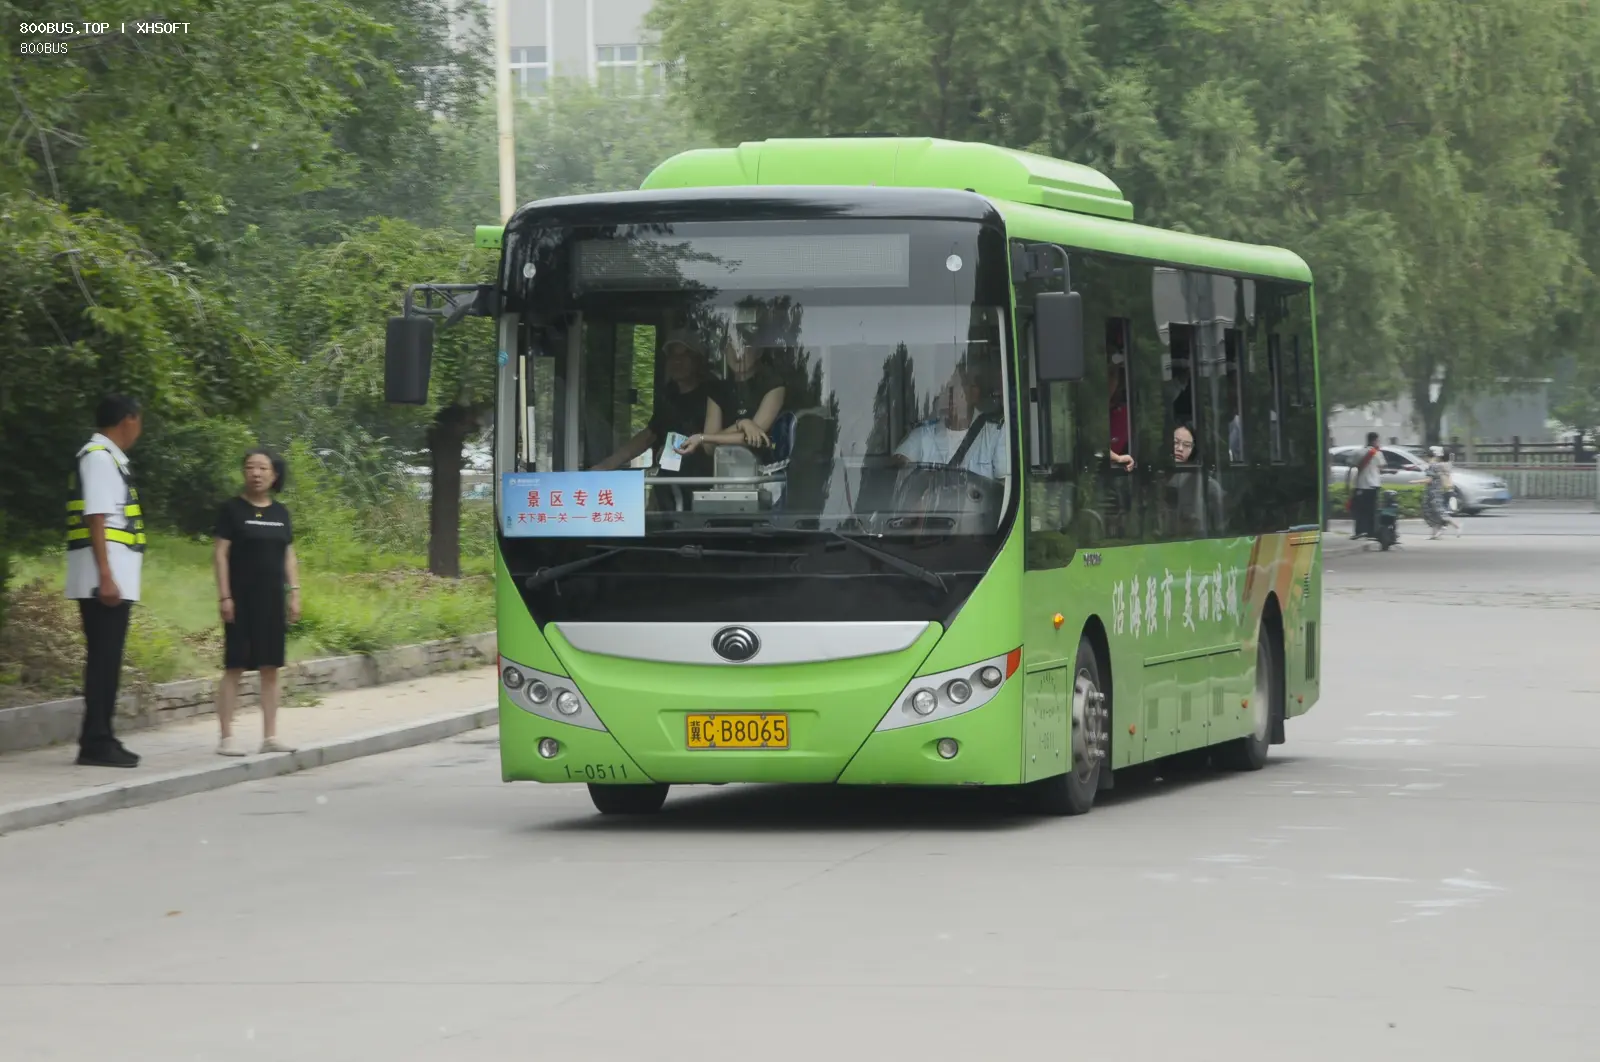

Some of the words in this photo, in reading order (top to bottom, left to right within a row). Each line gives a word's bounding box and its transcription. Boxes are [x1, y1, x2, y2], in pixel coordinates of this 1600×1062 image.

[527, 489, 614, 508] 景区专线
[563, 764, 628, 779] 1-0511
